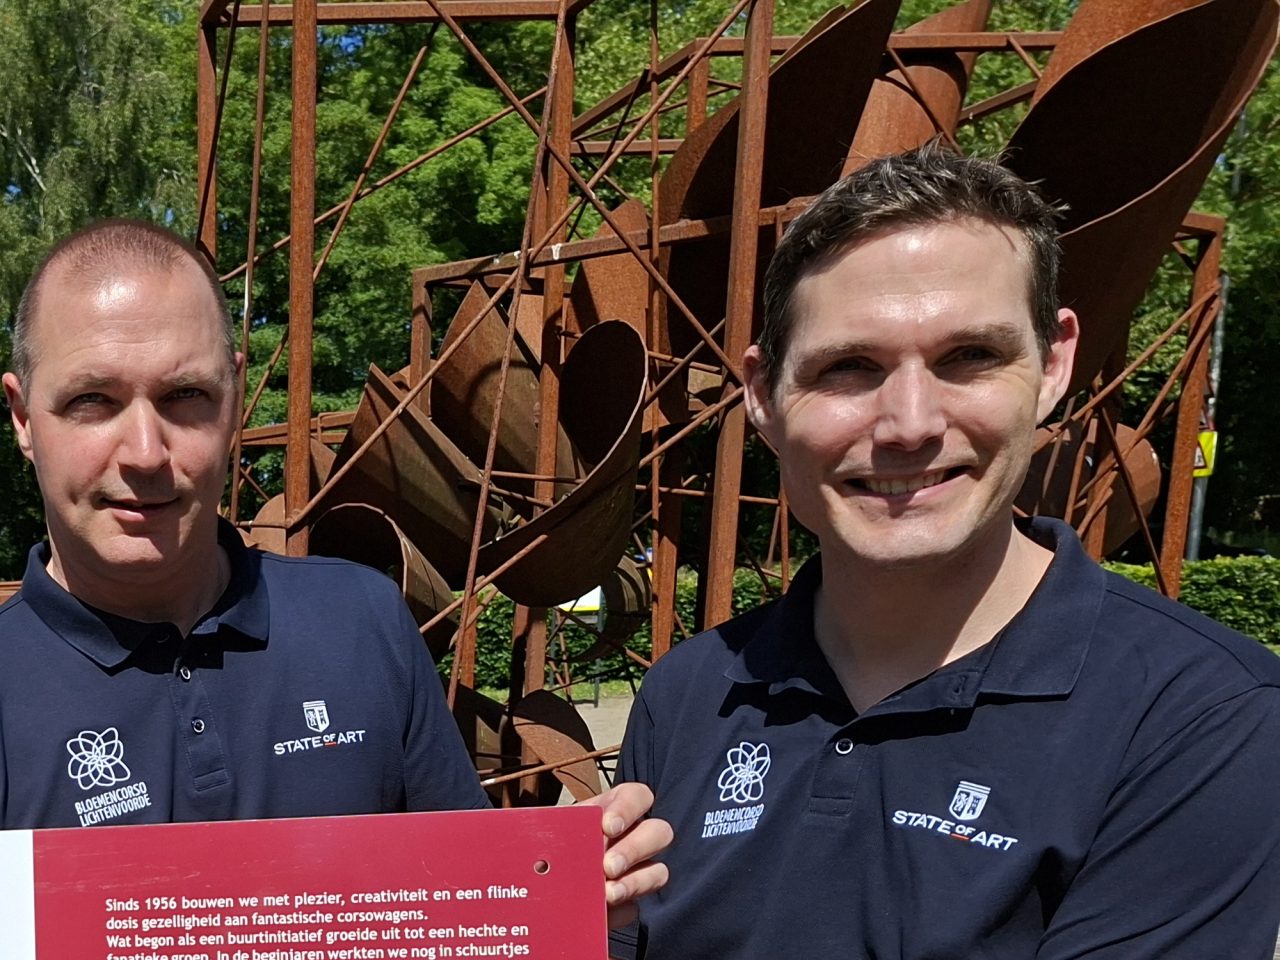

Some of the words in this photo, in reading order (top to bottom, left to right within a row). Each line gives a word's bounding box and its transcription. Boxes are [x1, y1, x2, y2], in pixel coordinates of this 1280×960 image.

[274, 736, 322, 755] STATE
[322, 734, 337, 743] OF
[337, 730, 366, 744] ART
[74, 782, 148, 815] BLOEMENCORSO
[79, 794, 152, 827] LICHTENVOORDE
[892, 810, 955, 835] STATE
[955, 825, 975, 835] OF
[970, 831, 1018, 851] ART
[105, 898, 139, 911] Sinds
[145, 897, 177, 910] 1956
[182, 896, 234, 909] bouwen
[238, 897, 258, 907] we
[263, 894, 290, 906] met
[294, 891, 345, 908] plezier,
[350, 888, 428, 903] creativiteit
[433, 890, 450, 900] en
[456, 889, 482, 899] een
[487, 885, 528, 898] flinke
[106, 916, 138, 929] dosis
[141, 913, 220, 931] gezelligheid
[224, 915, 248, 926] aan
[251, 910, 333, 925] fantastische
[337, 910, 428, 923] corsowagens.
